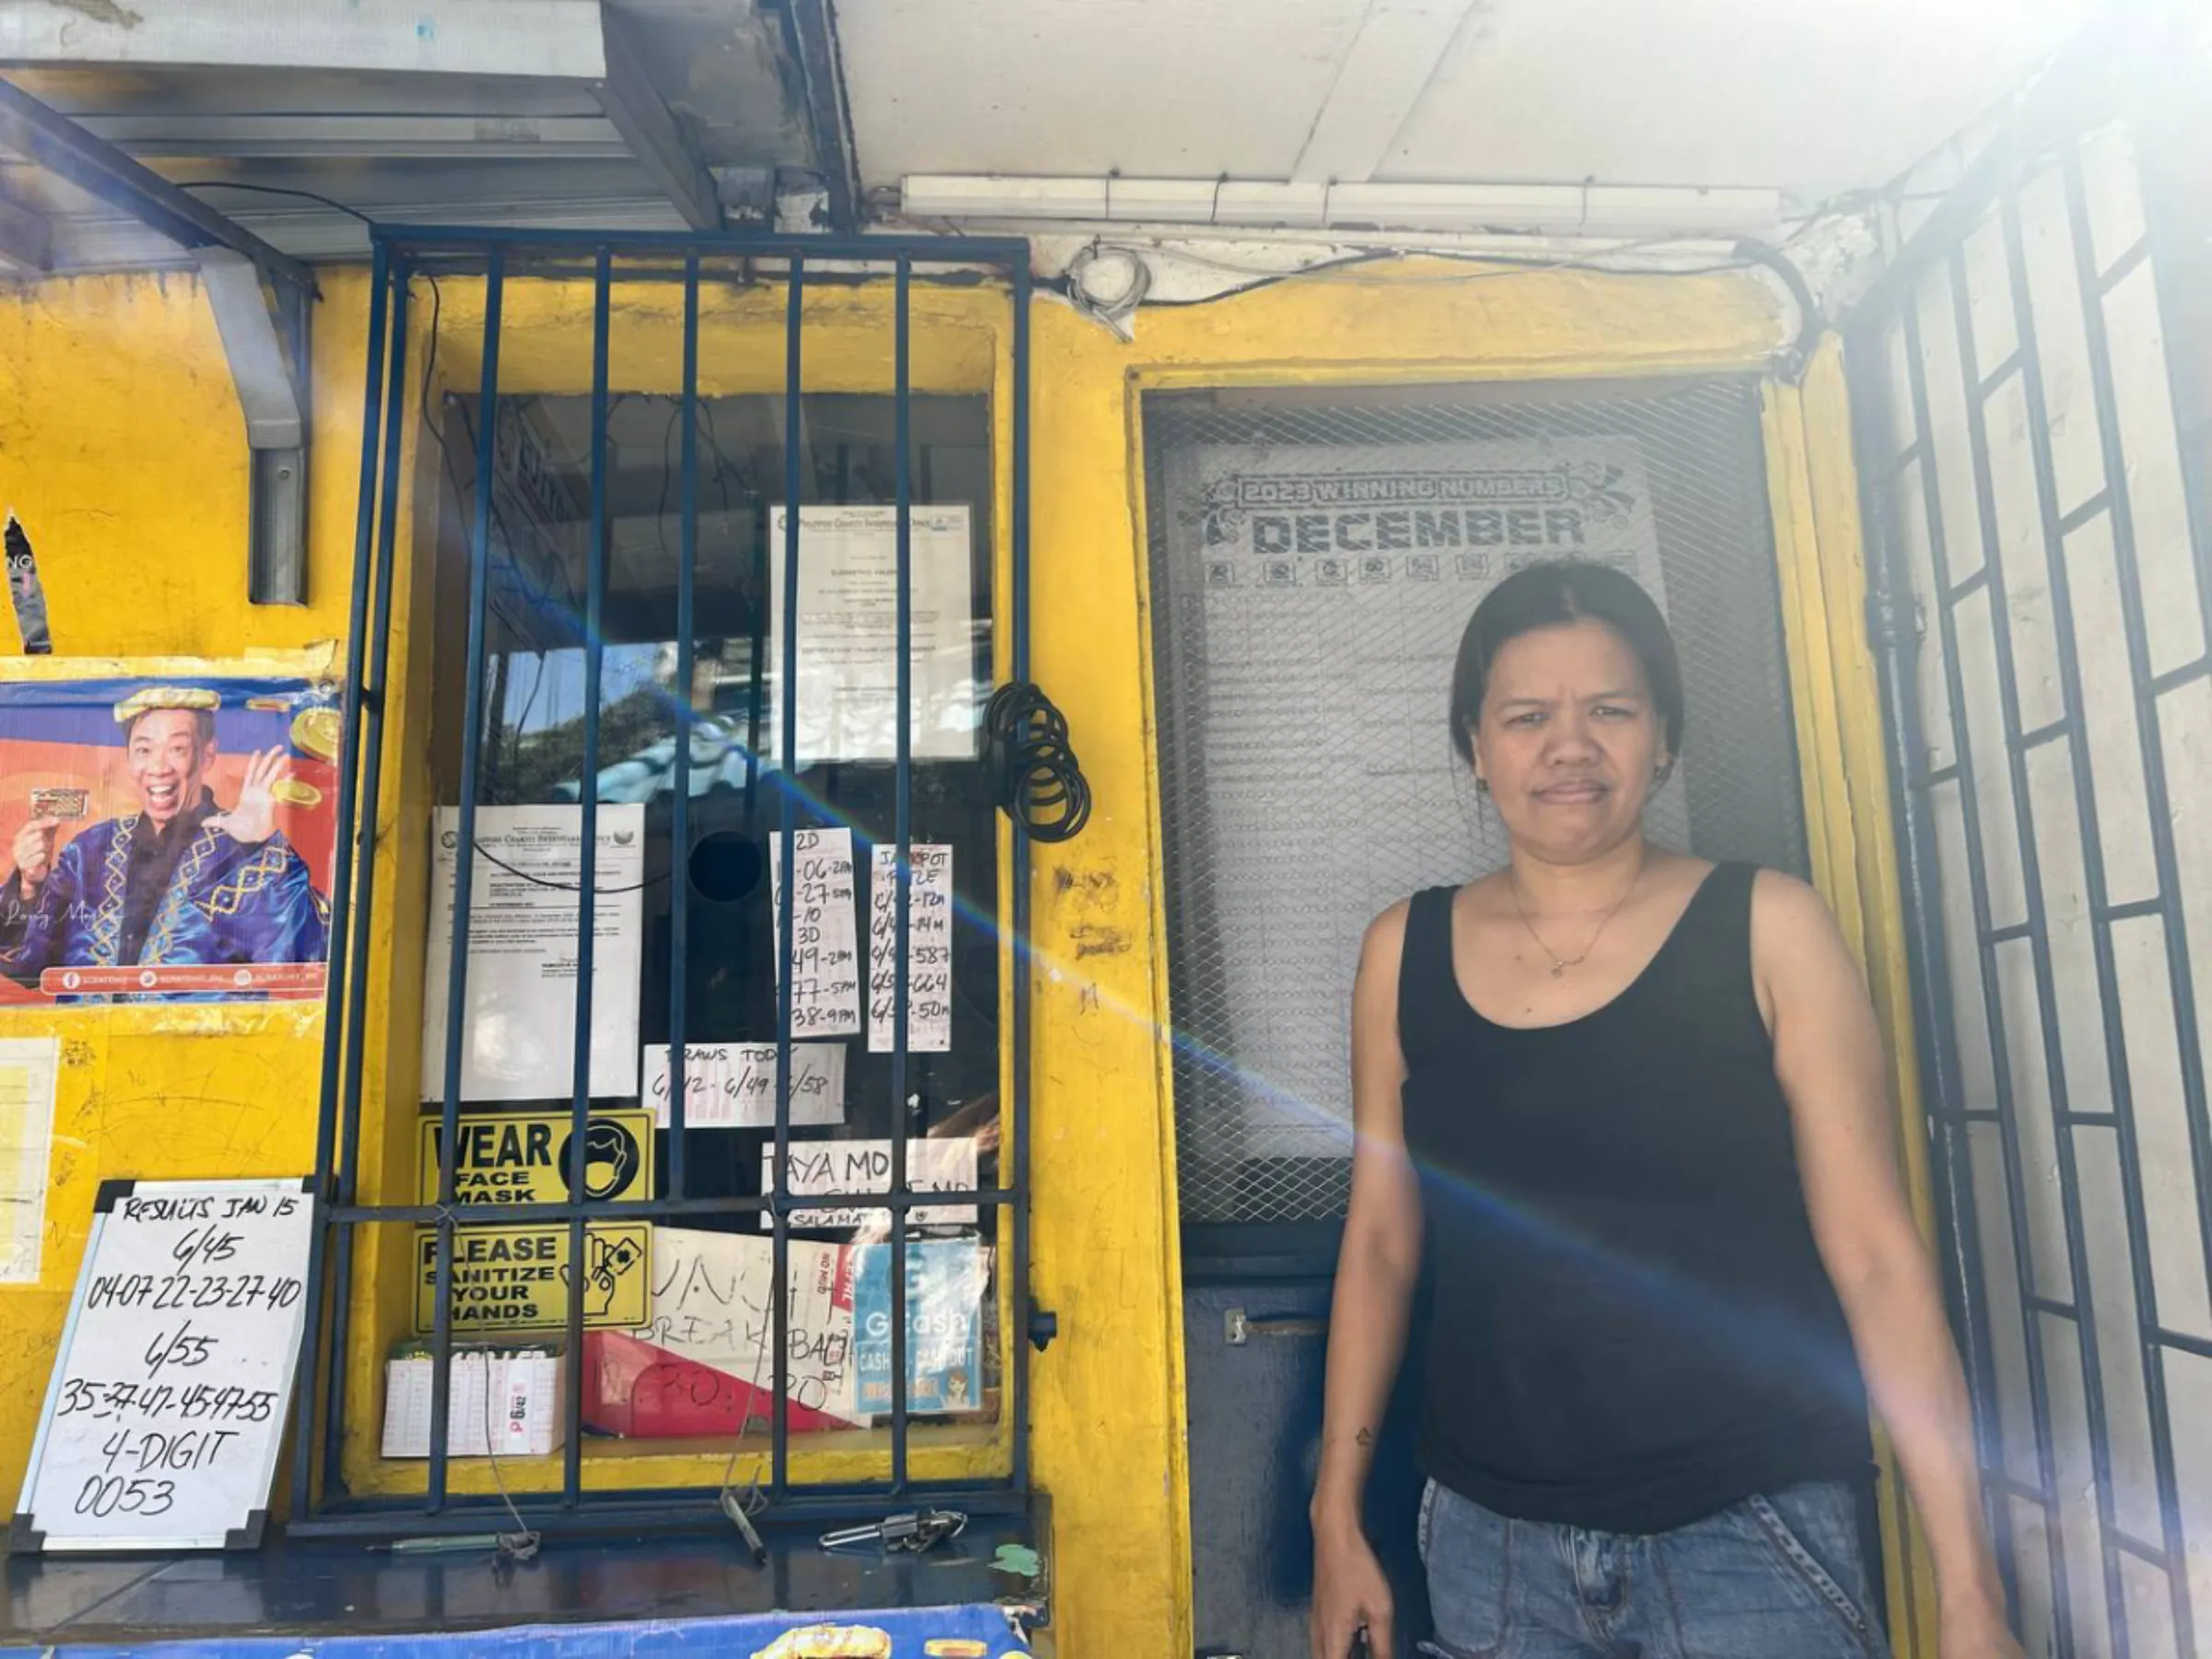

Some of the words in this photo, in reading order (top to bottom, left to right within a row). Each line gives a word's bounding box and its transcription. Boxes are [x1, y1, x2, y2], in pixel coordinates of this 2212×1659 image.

[1243, 480, 1314, 504] 2023
[1315, 478, 1437, 502] WINNING
[1439, 477, 1565, 499] NUMBERS
[1253, 509, 1584, 553] DECEMBER
[796, 832, 819, 851] 2D
[797, 926, 820, 945] 3D
[665, 1047, 727, 1062] RAWS
[740, 1045, 798, 1062] TOD
[455, 1171, 530, 1187] FACE
[845, 1149, 889, 1182] MO
[220, 1194, 267, 1218] JAN
[273, 1196, 300, 1218] 15
[172, 1223, 245, 1276] 6/45
[451, 1285, 530, 1301] YOUR
[865, 1308, 969, 1337] Gash
[144, 1319, 219, 1380] 6/55
[102, 1429, 240, 1474] 4-DIGIT
[75, 1475, 176, 1518] 0053
